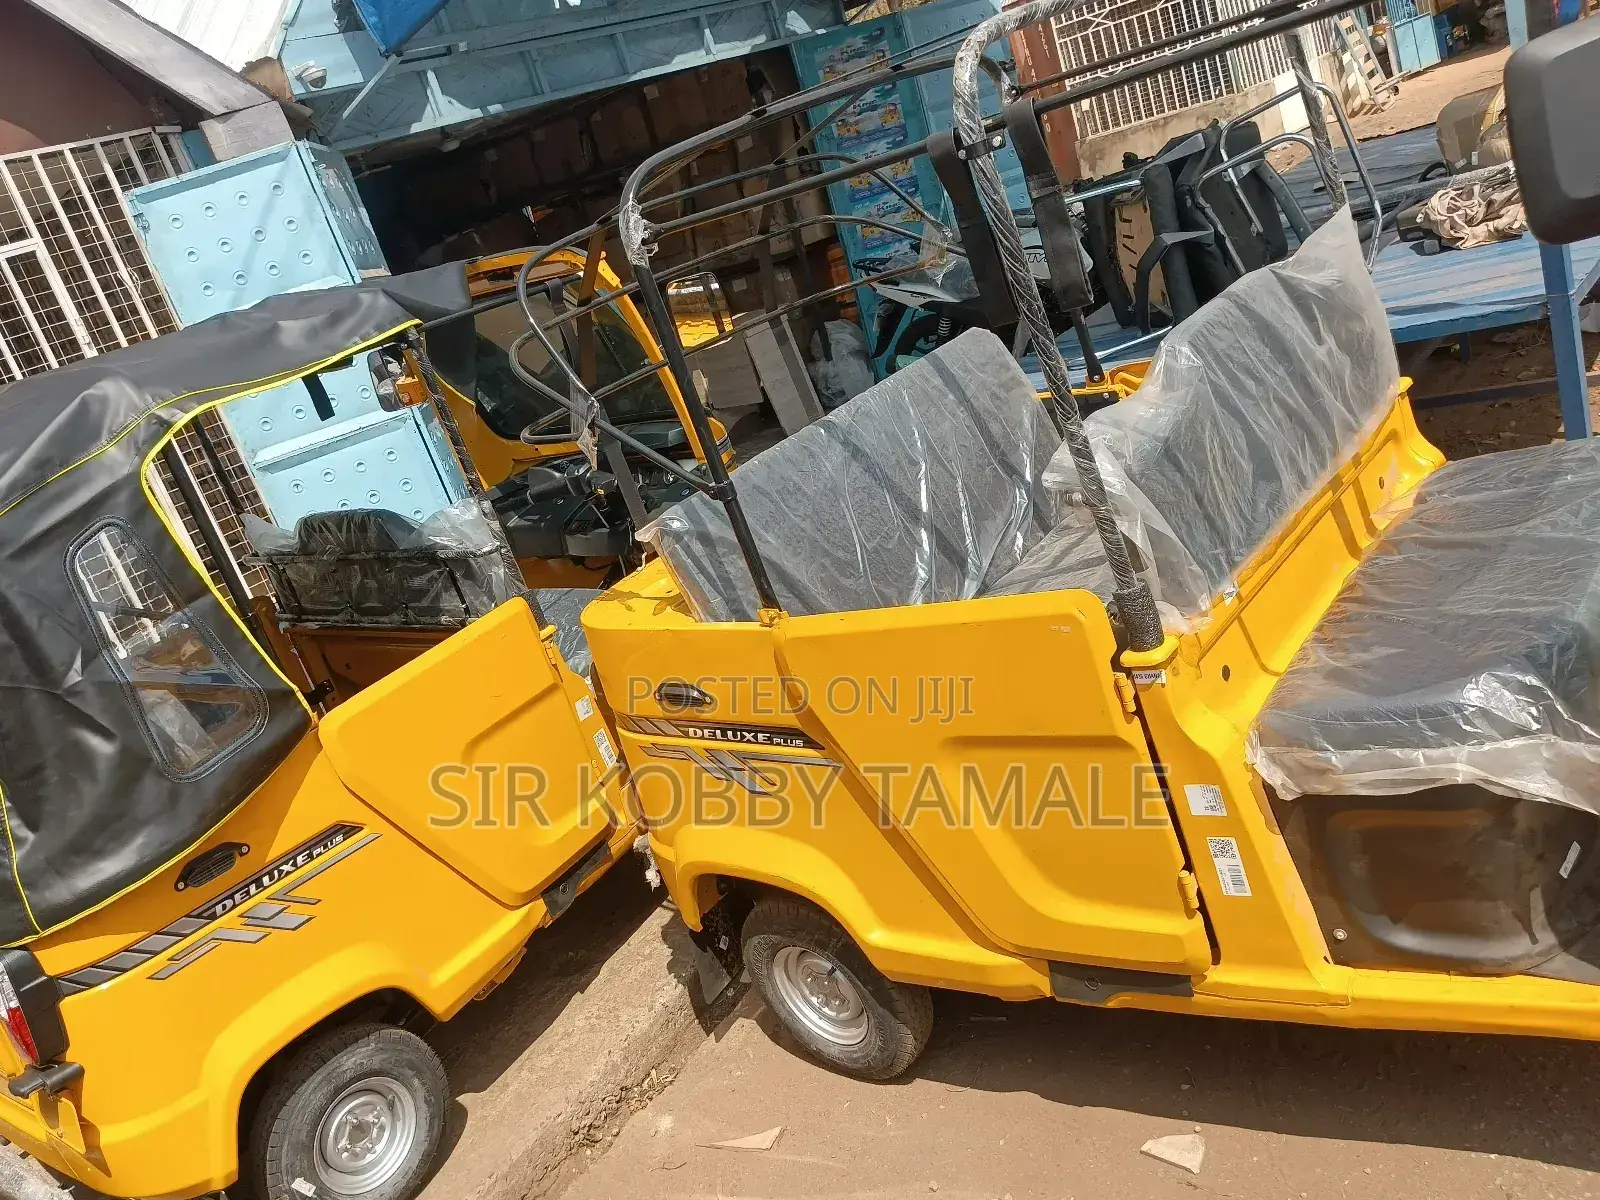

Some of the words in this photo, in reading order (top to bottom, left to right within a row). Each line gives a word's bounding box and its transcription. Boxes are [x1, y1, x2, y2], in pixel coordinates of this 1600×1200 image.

[688, 727, 771, 745] DELUXE
[773, 737, 804, 748] PLUS
[216, 850, 310, 918] DELUXE
[313, 833, 344, 859] PLUS
